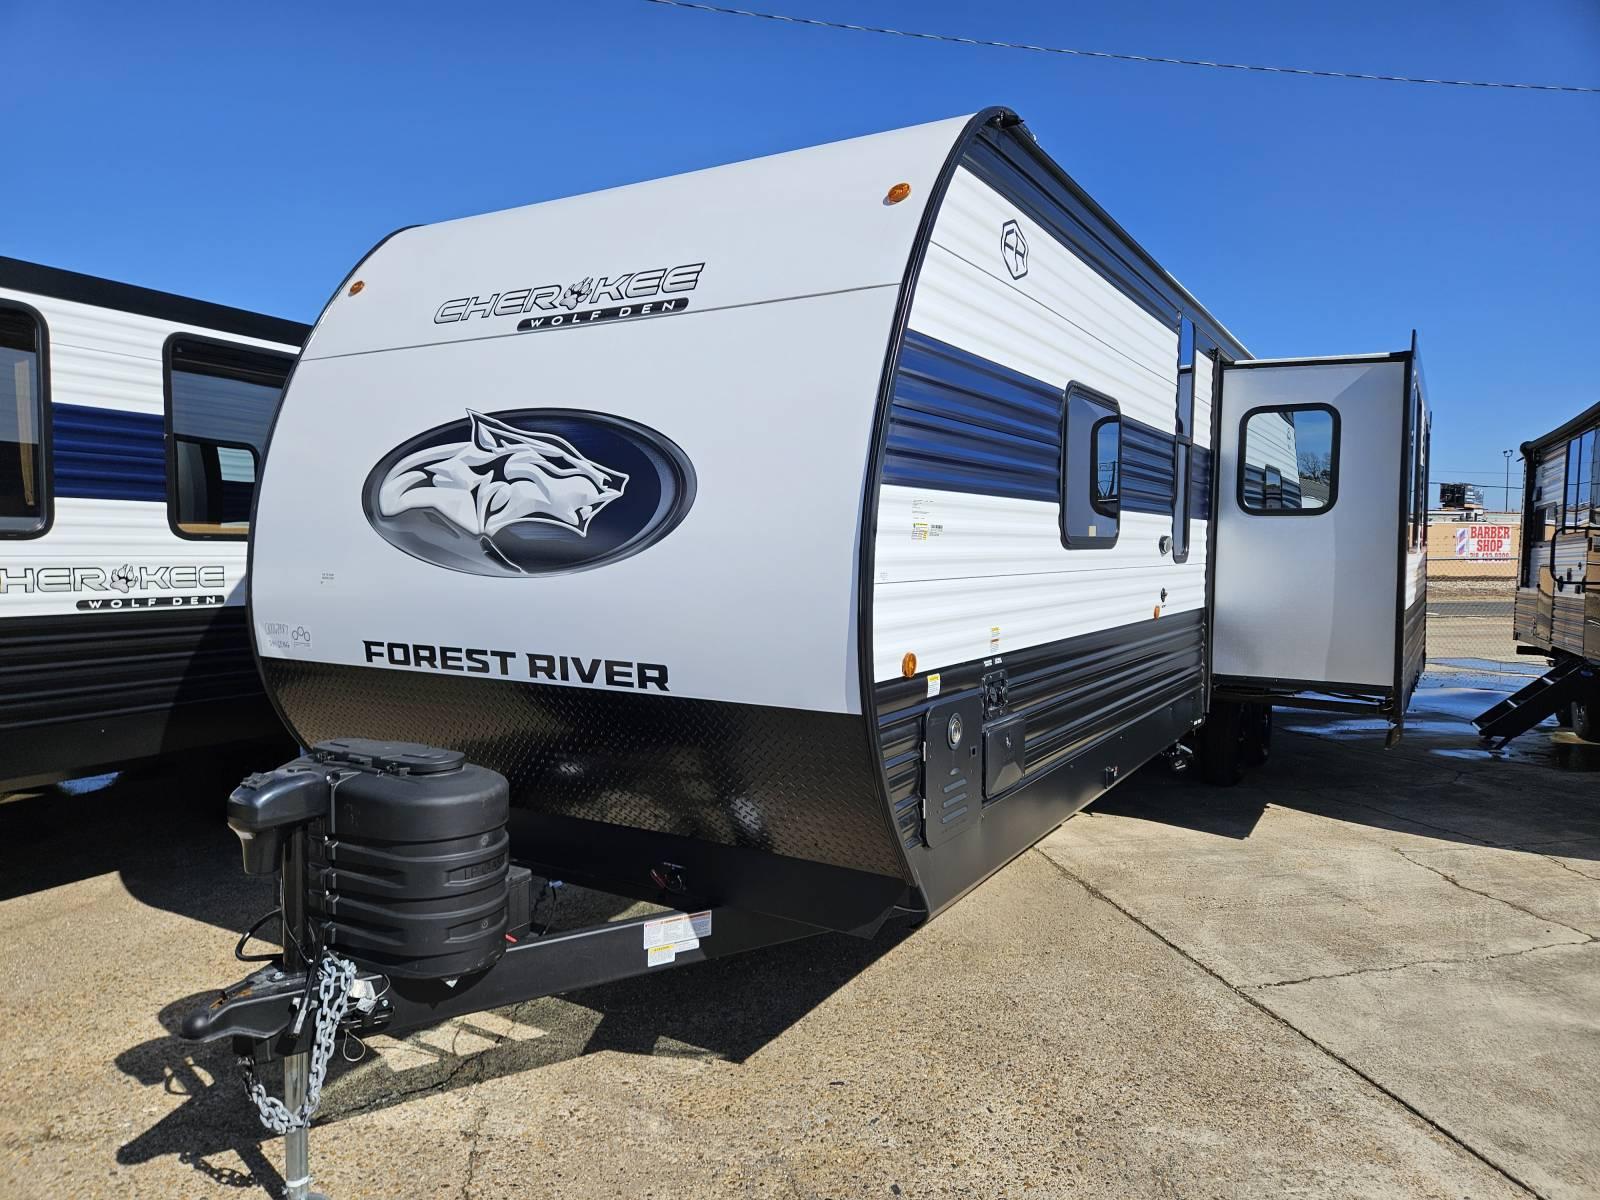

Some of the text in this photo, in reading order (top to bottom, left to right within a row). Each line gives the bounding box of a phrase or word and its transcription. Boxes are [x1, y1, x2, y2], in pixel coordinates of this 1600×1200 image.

[530, 301, 676, 328] WOLF DEN
[1470, 526, 1510, 539] BARBER
[1476, 539, 1503, 552] SHOP
[89, 595, 216, 609] WOLF DEN
[362, 640, 670, 691] FOREST RIVER
